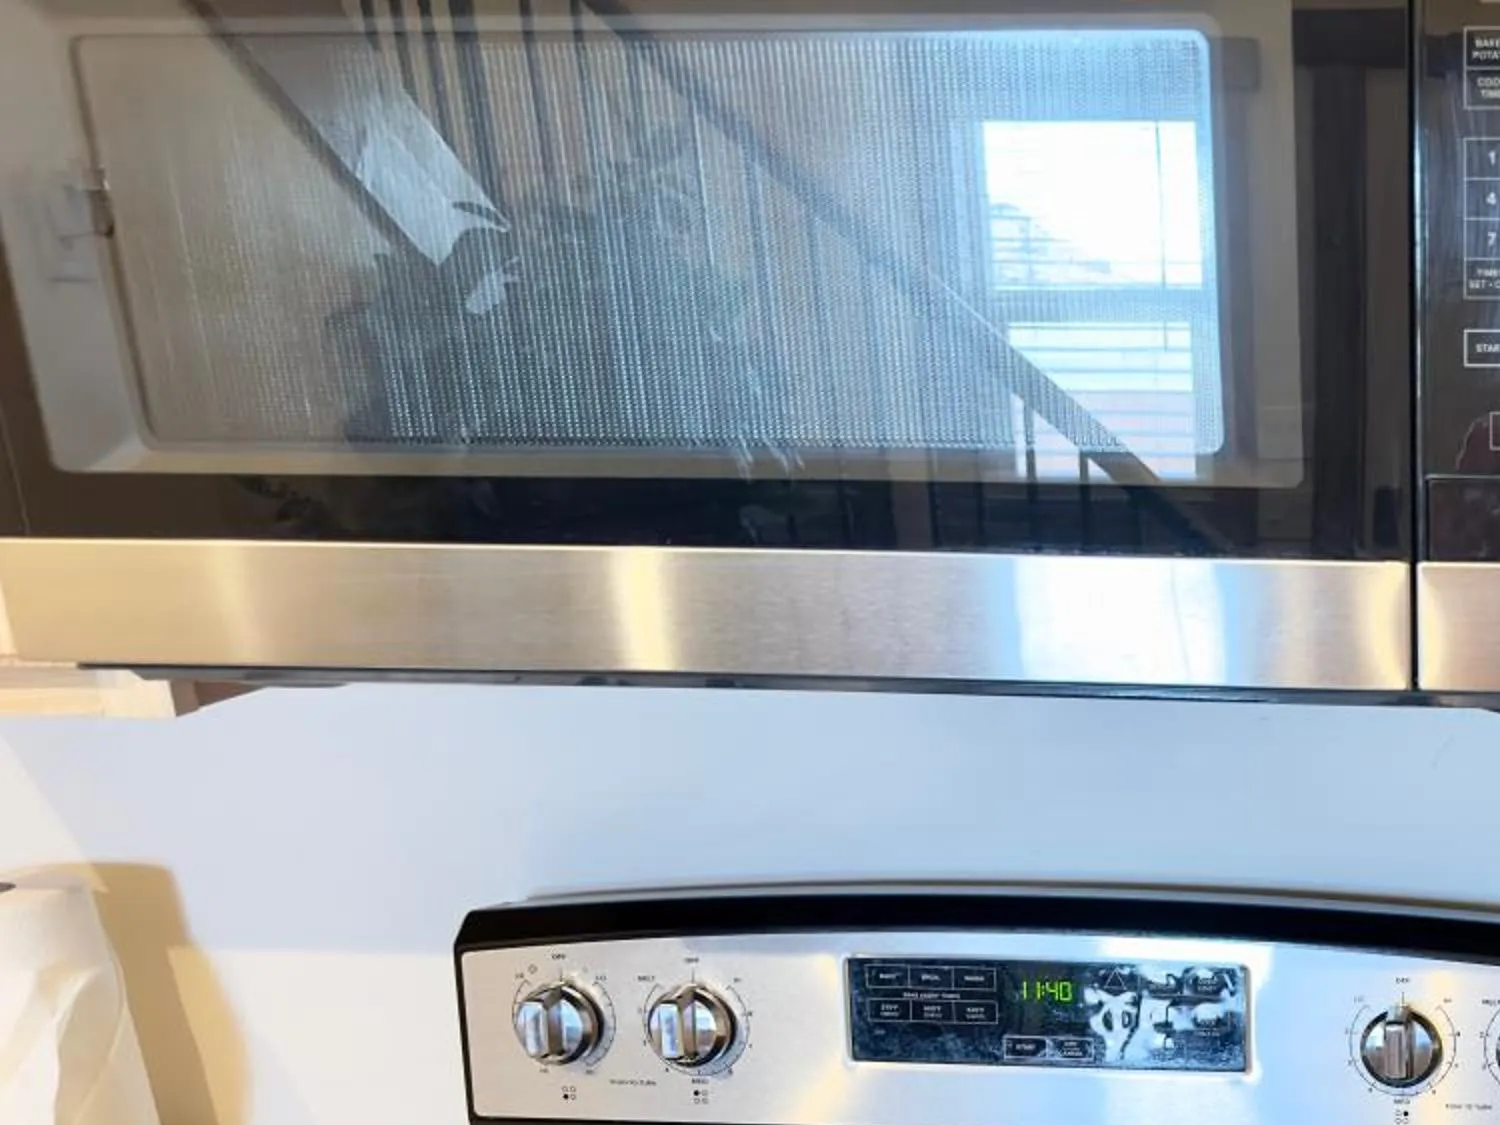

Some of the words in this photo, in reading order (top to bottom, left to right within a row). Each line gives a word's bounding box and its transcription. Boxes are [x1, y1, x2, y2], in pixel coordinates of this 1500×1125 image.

[1487, 151, 1497, 165] 1
[1487, 192, 1497, 206] 4
[1487, 231, 1497, 247] 7
[1022, 980, 1073, 1001] 11:40
